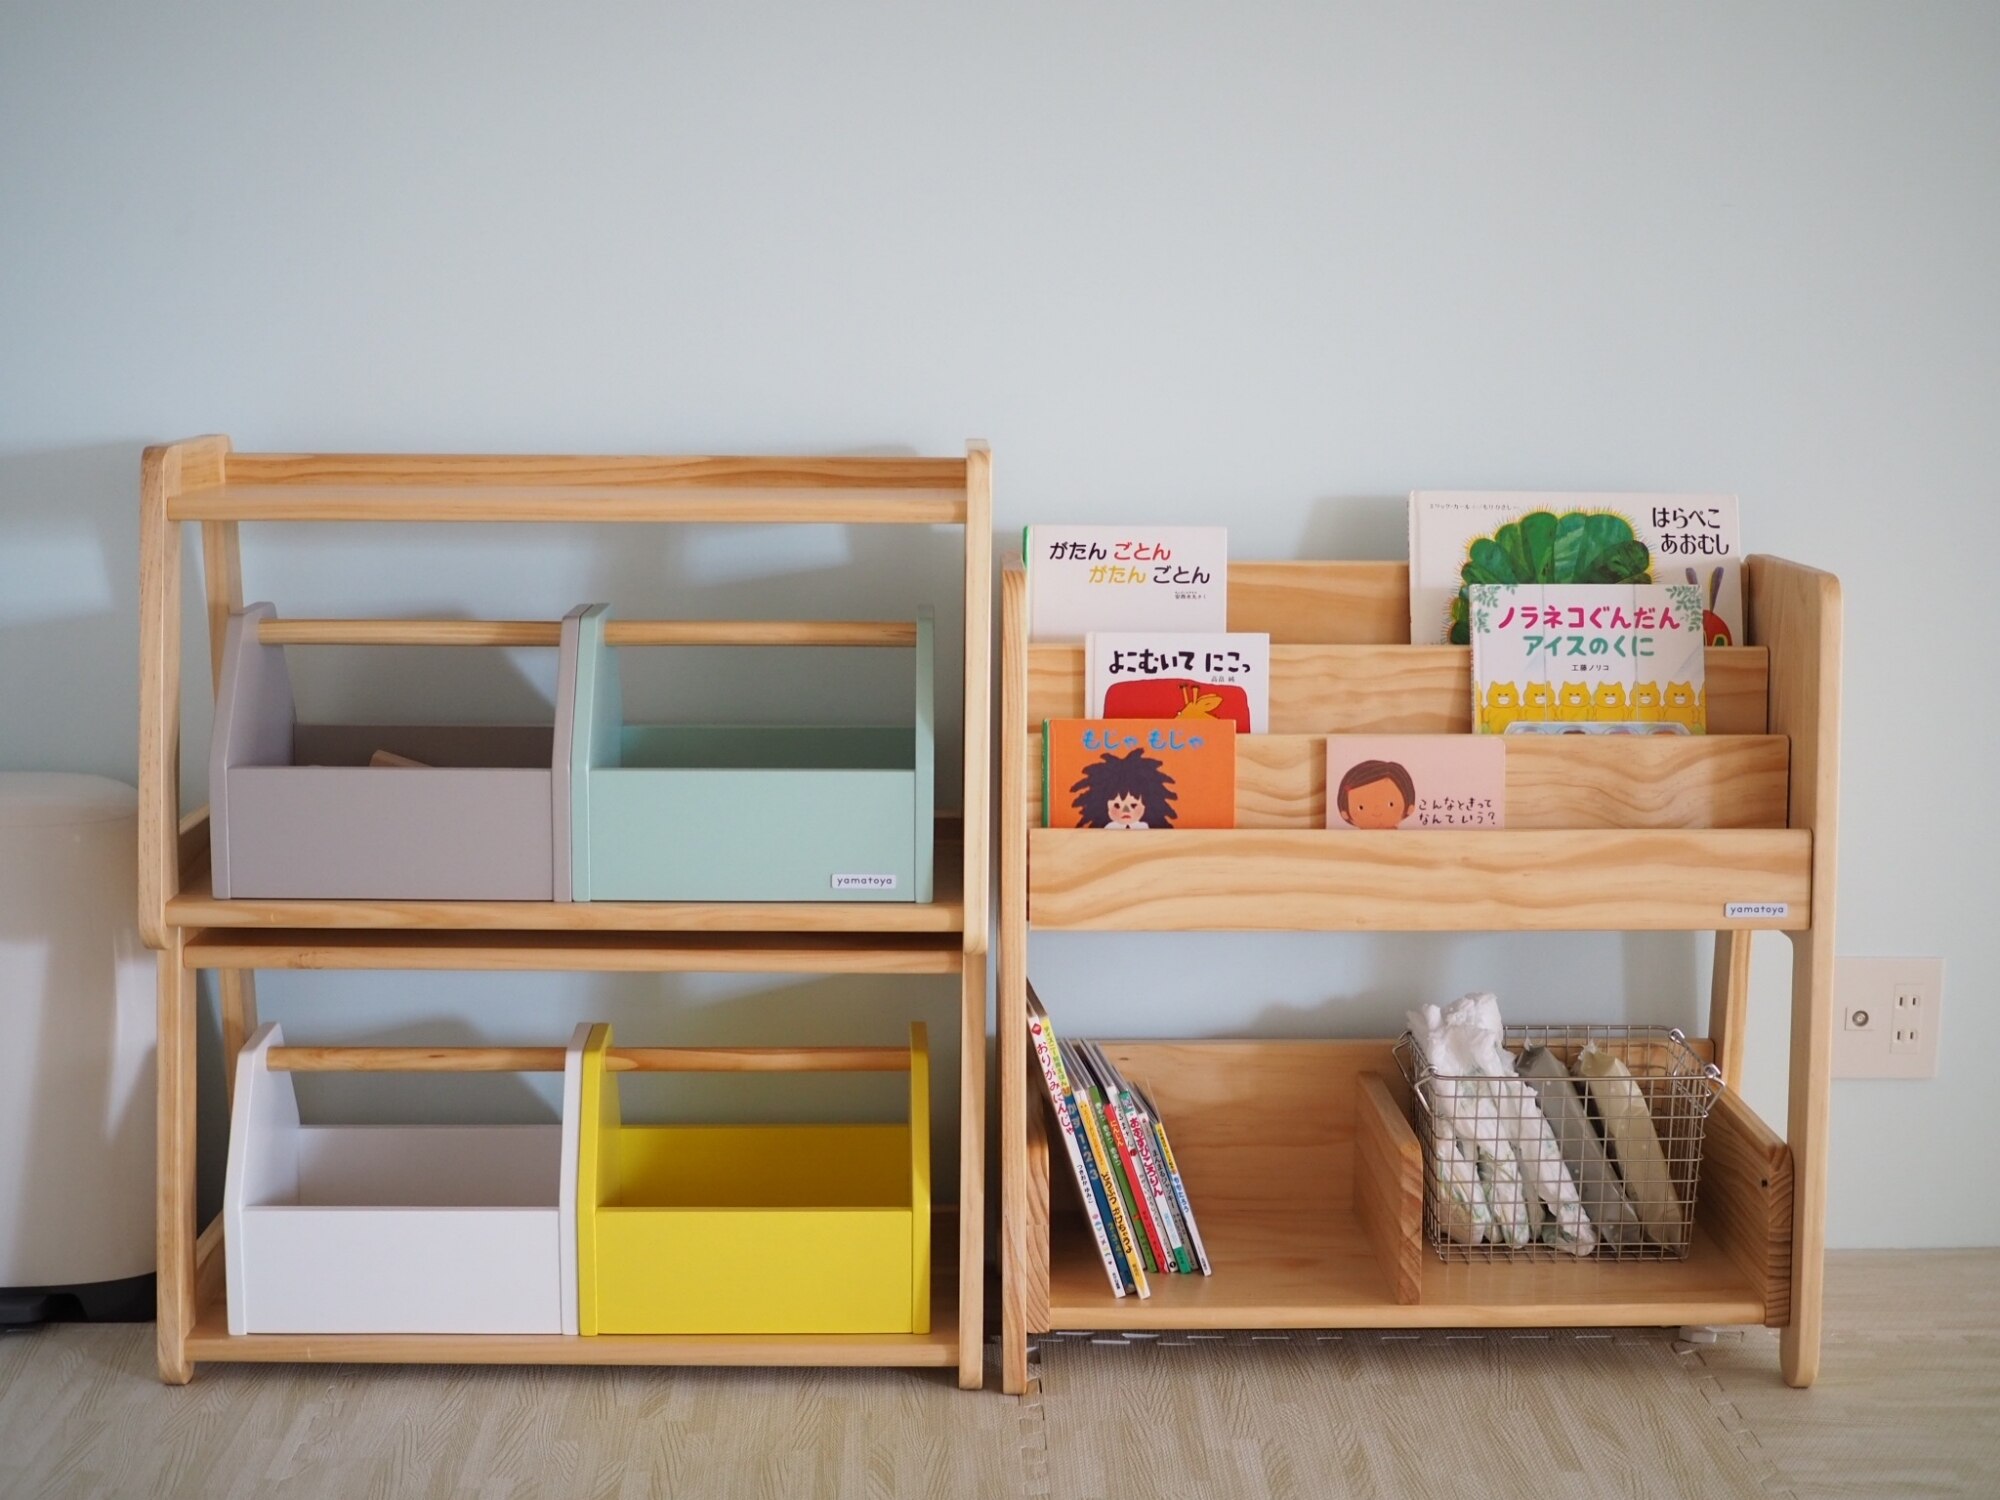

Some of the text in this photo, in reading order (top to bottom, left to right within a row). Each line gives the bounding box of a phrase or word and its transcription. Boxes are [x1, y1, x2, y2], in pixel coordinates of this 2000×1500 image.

[1652, 507, 1721, 529] はらぺこ
[1050, 542, 1171, 561] がたん ごとん
[1661, 533, 1730, 556] あおむし
[1088, 565, 1210, 584] がたん ごとん
[1498, 605, 1681, 630] ノラネコぐんだん
[1523, 635, 1655, 657] アイスのくに
[1109, 649, 1251, 674] よこむいて にこっ
[1419, 796, 1493, 811] こんなときって
[837, 877, 893, 887] yamatoya
[1730, 905, 1784, 916] yamatoya
[1036, 1042, 1075, 1135] おりがみにんじゃ
[1109, 1119, 1123, 1146] にんじん
[1129, 1117, 1163, 1197] おむすびころりん
[1101, 1171, 1118, 1204] どうぶつ
[1172, 1176, 1189, 1213] ももたろう
